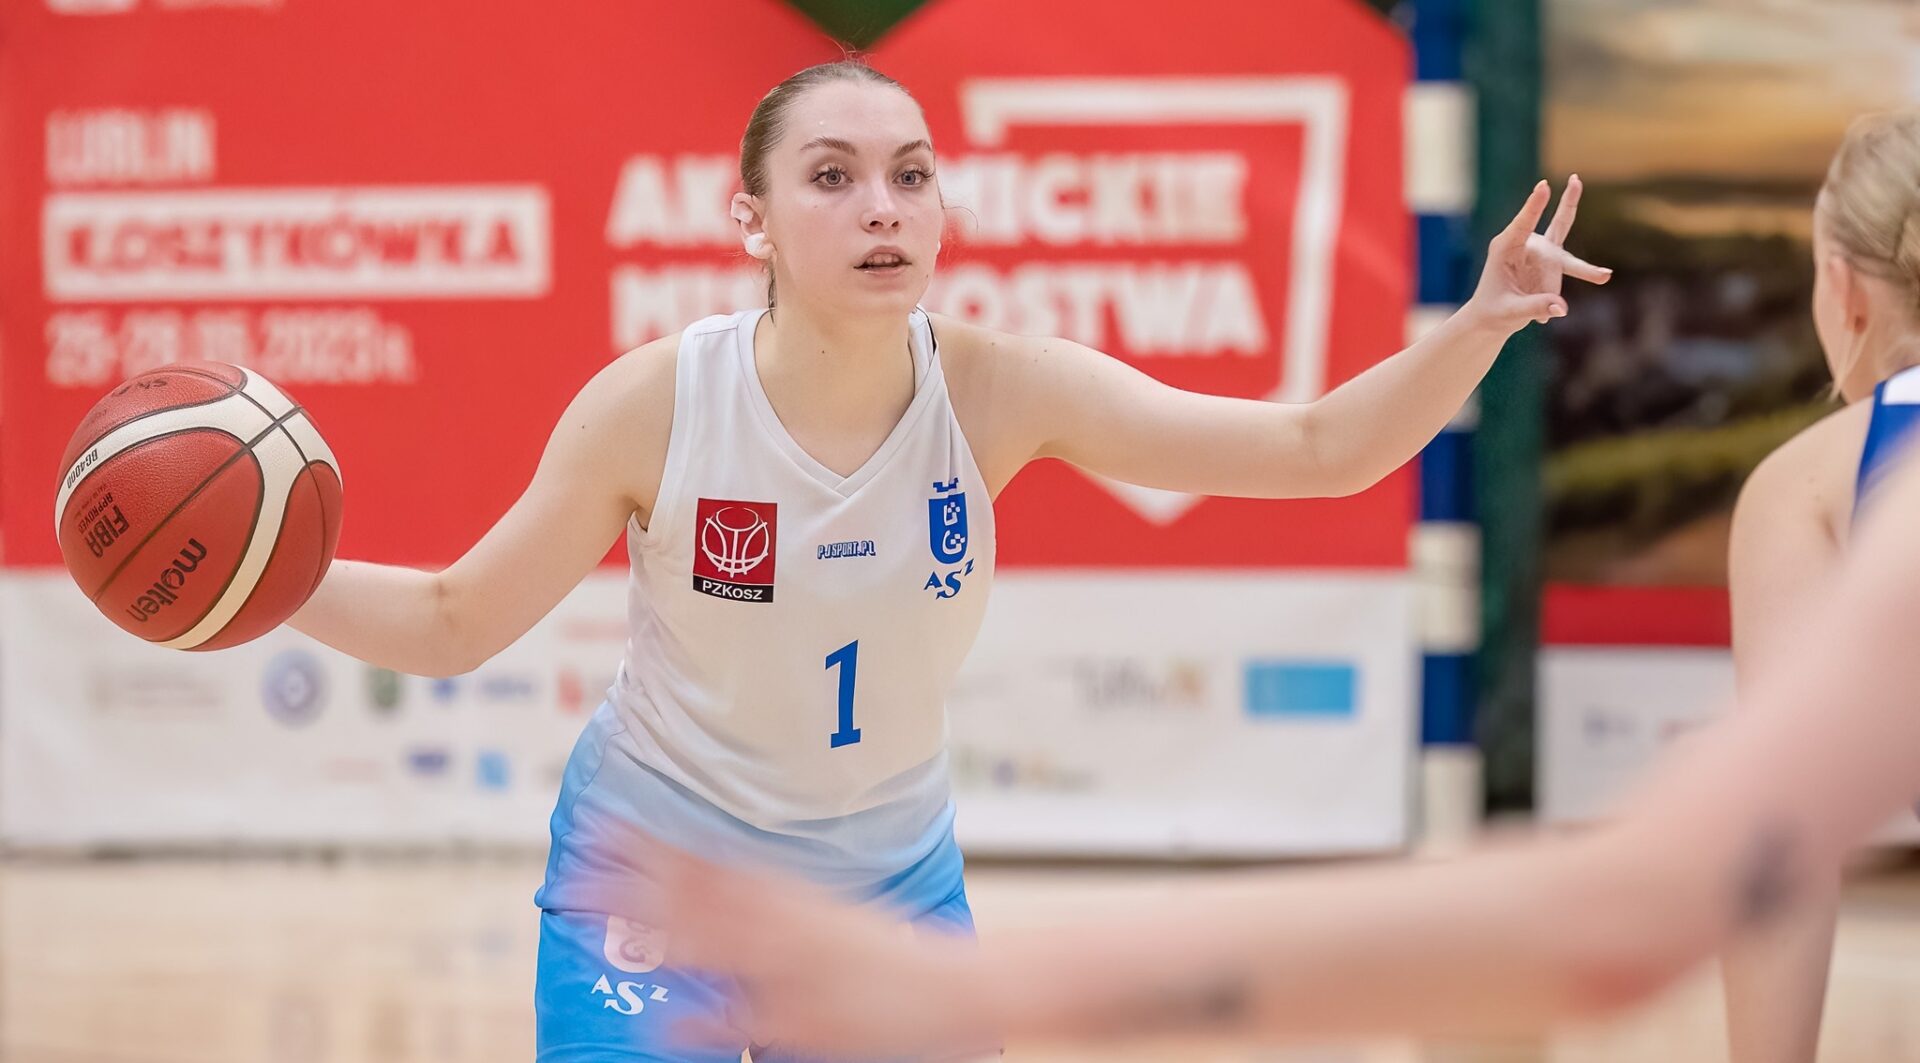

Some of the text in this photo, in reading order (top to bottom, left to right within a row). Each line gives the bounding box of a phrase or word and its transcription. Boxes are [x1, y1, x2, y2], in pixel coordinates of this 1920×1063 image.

[78, 491, 114, 530] APPROVED
[84, 505, 130, 558] FIBA
[125, 537, 208, 623] molten
[825, 640, 862, 749] 1
